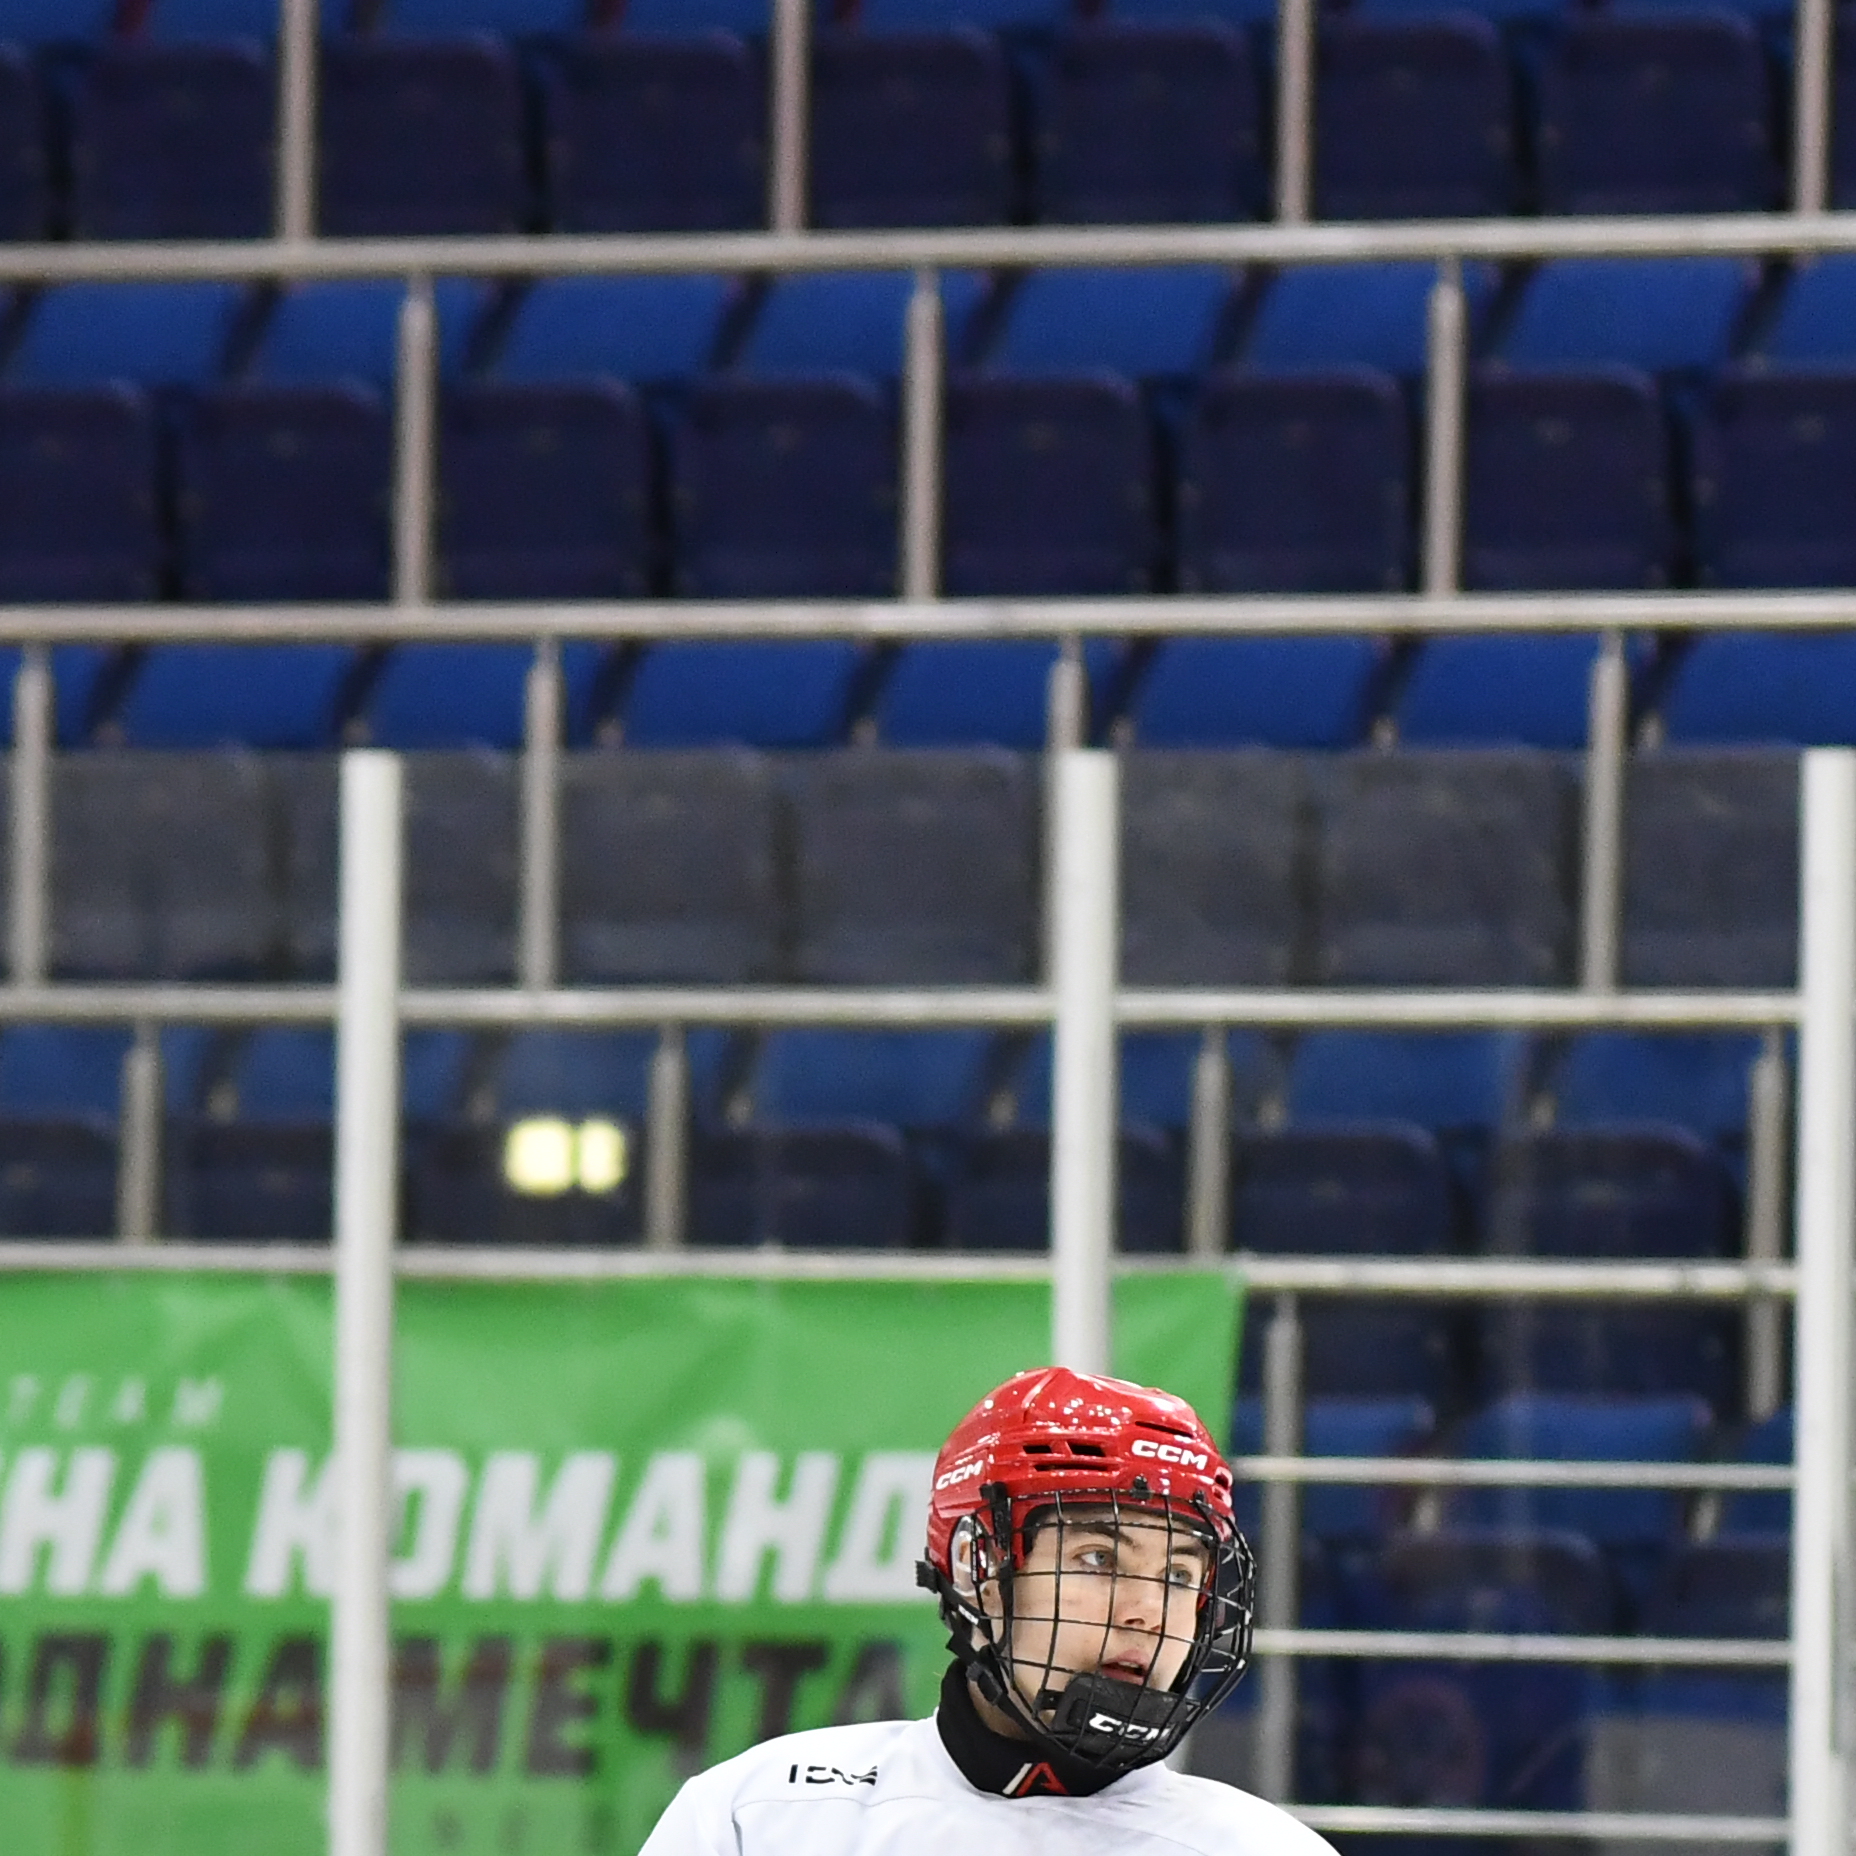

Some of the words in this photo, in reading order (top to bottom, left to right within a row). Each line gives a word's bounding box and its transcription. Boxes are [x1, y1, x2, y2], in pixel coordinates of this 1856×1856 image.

[1132, 1440, 1208, 1471] CCM
[936, 1460, 984, 1490] CCM
[246, 1446, 936, 1604] КОМАНД
[388, 1632, 912, 1782] МЕЧТА
[1089, 1713, 1171, 1742] CCM
